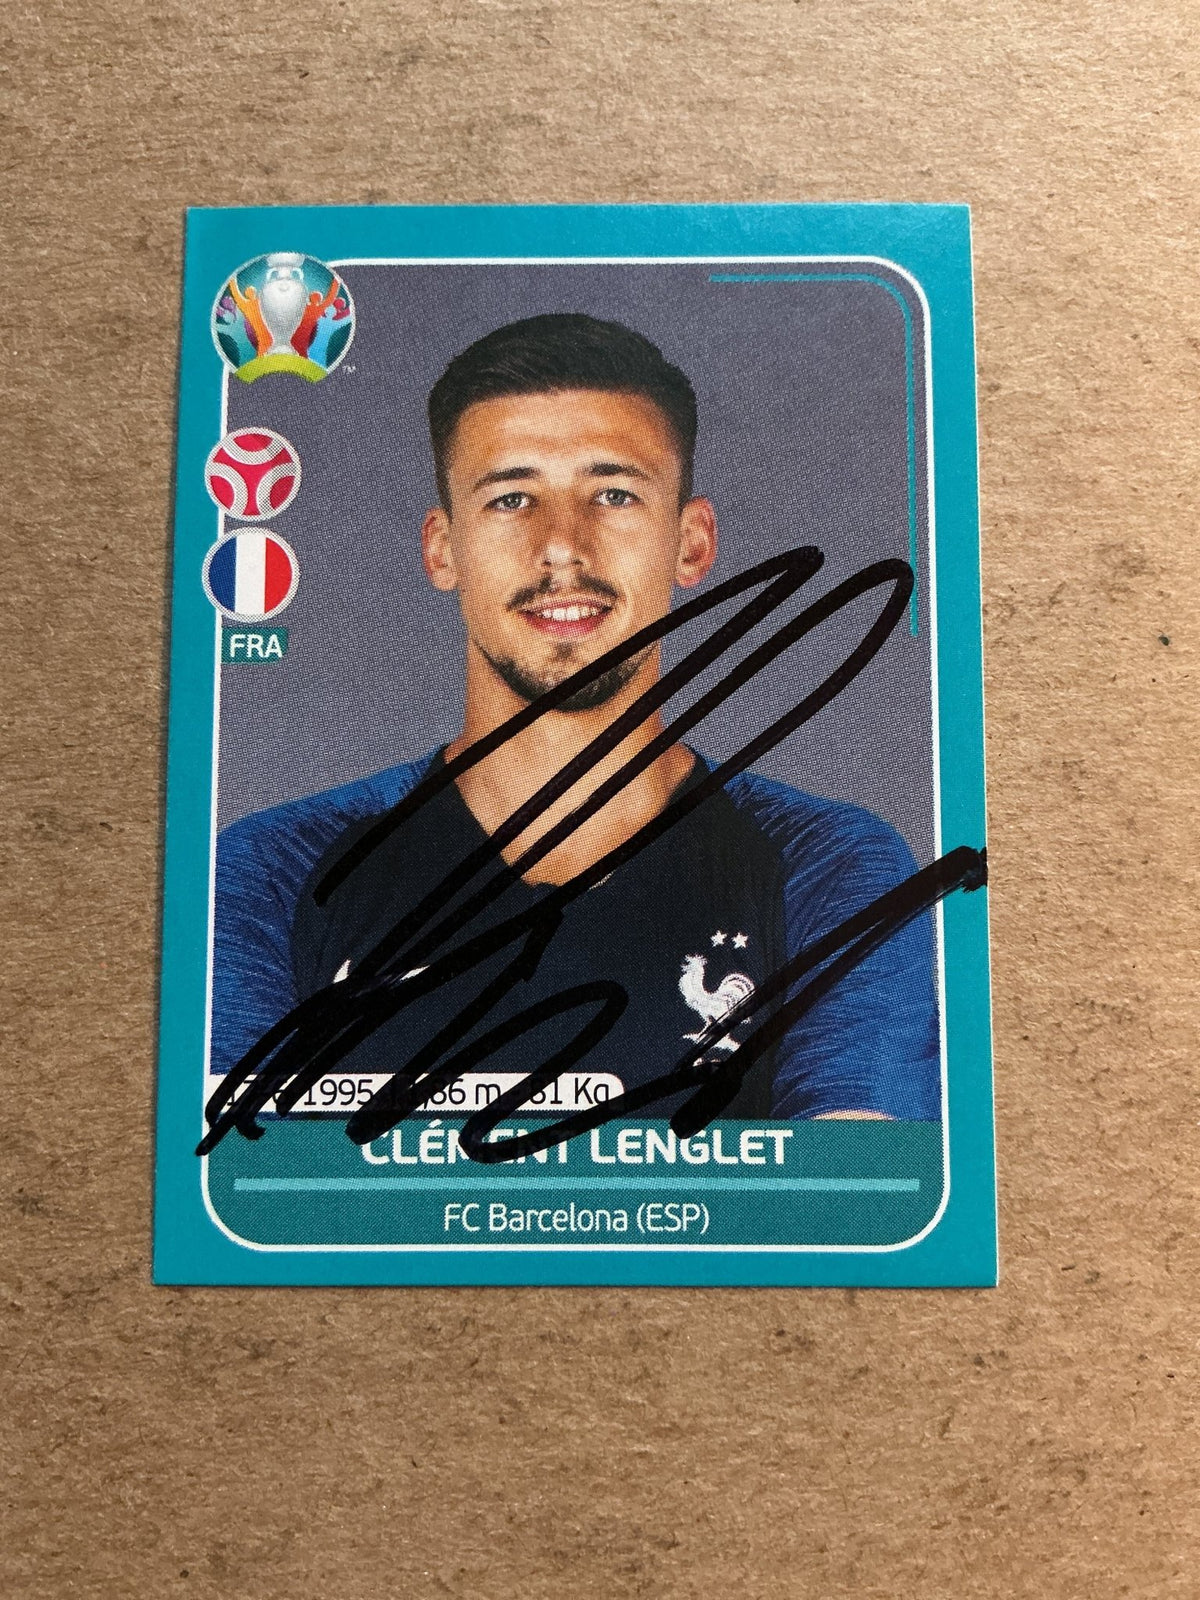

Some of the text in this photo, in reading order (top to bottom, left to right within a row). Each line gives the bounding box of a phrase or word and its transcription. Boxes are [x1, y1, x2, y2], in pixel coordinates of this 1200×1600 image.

[229, 633, 283, 658] FRA
[590, 1128, 794, 1165] LENGLET
[443, 1201, 710, 1235] FC Barcelona (ESP)
